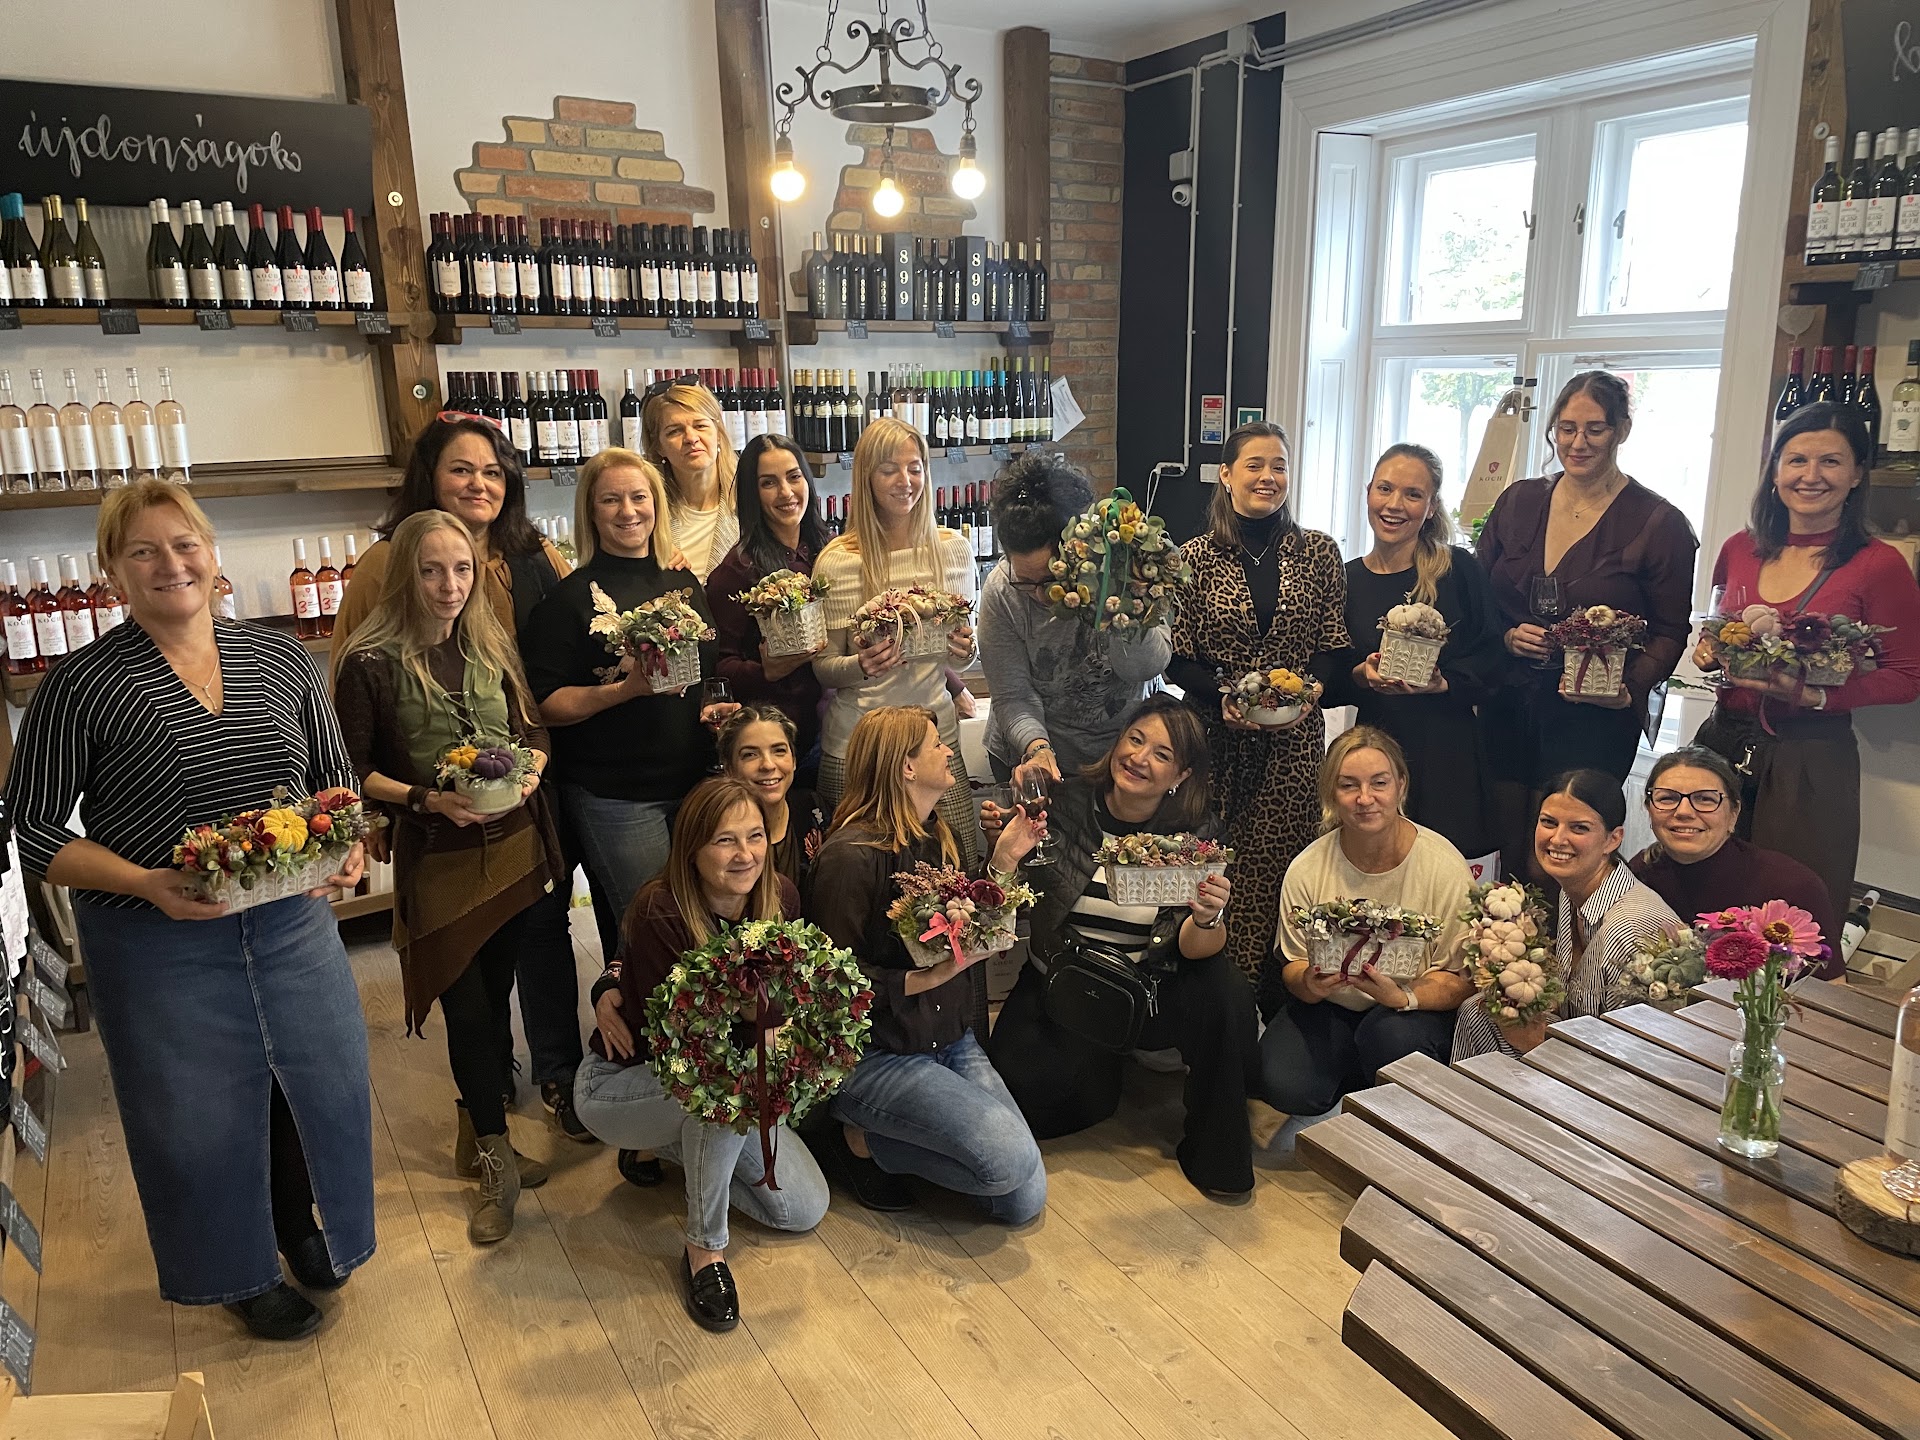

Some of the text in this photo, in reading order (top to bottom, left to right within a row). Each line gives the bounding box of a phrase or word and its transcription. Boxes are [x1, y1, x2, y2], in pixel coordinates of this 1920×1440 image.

[18, 110, 301, 194] újdonságok
[899, 249, 909, 305] 899
[971, 252, 981, 306] 899
[298, 600, 307, 613] 3
[322, 597, 331, 610] 3
